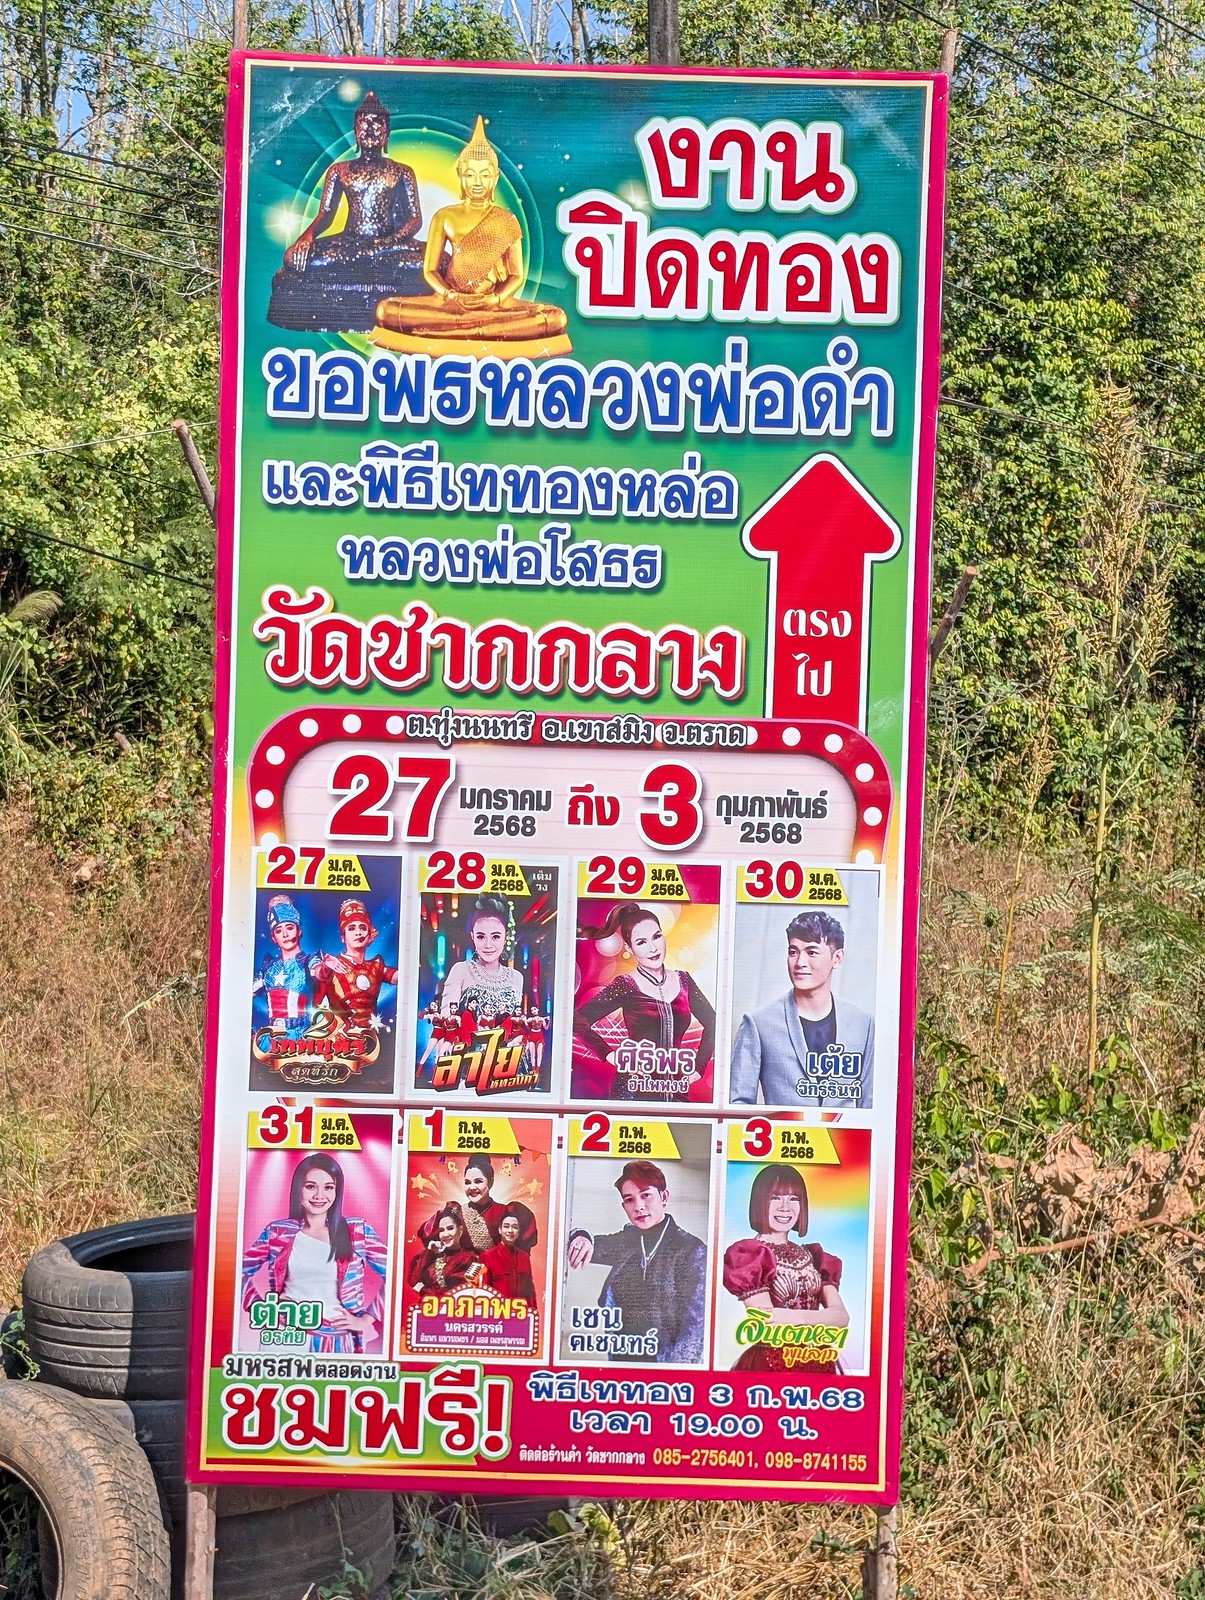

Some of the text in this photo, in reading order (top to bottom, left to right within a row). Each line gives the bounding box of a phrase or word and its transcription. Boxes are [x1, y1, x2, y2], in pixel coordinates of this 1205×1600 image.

[643, 122, 849, 208] งาน
[563, 196, 894, 319] ปิดทอง
[264, 337, 894, 436] ขอพรหลวงพ่อดำ
[263, 443, 739, 519] และพิธีเททองหล่อ
[339, 525, 663, 588] หลวงพ่อโสธร
[782, 608, 853, 638] ตรง
[791, 652, 833, 697] ไป
[407, 708, 748, 746] ต.ทุ่งนนทรี อ.เขาสมิง จ.ตราด
[329, 754, 454, 842] 27
[459, 786, 553, 812] มกราคม
[567, 783, 621, 827] ถึง
[638, 762, 699, 847] 3
[715, 789, 829, 825] กุมภาพันธ์
[474, 814, 537, 837] 2568
[739, 821, 803, 844] 2568
[266, 846, 326, 885] 27
[328, 858, 357, 872] ม.ค.
[426, 850, 486, 890] 28
[490, 863, 519, 877] ม.ค.
[586, 856, 646, 895] 29
[651, 868, 680, 882] ม.ค.
[745, 860, 804, 899] 30
[809, 872, 838, 886] ม.ค.
[327, 874, 362, 887] 2568
[490, 878, 524, 892] 2568
[535, 883, 548, 892] วง
[650, 882, 684, 897] 2568
[808, 887, 842, 901] 2568
[431, 1027, 524, 1092] ลำไย
[617, 1040, 696, 1074] ศิริพร
[807, 1044, 862, 1077] เต้ย
[628, 1075, 690, 1093] อำไพพงษ์
[259, 1105, 314, 1145] 31
[320, 1117, 350, 1132] ม.ค.
[320, 1132, 355, 1146] 2568
[424, 1109, 443, 1148] 1
[457, 1120, 487, 1135] ก.พ.
[580, 1113, 611, 1152] 2
[618, 1124, 648, 1139] ก.พ.
[743, 1119, 773, 1157] 3
[781, 1130, 810, 1144] ก.พ.
[457, 1136, 491, 1150] 2568
[617, 1140, 652, 1154] 2568
[780, 1145, 815, 1159] 2568
[251, 1292, 322, 1329] ต่าย
[421, 1294, 529, 1321] อาภาพร
[571, 1305, 622, 1330] เชน
[261, 1326, 305, 1345] อรทัย
[444, 1320, 504, 1335] นครสวรรค์
[570, 1327, 658, 1355] คเชนทร์
[528, 1371, 865, 1410] พิธีเททอง 3 ก.พ.68
[223, 1366, 506, 1454] ชมฟรี!
[571, 1408, 818, 1439] เวลา 19.00 น.
[652, 1446, 760, 1470] 085-2756401,
[765, 1451, 867, 1472] 098-8741155
